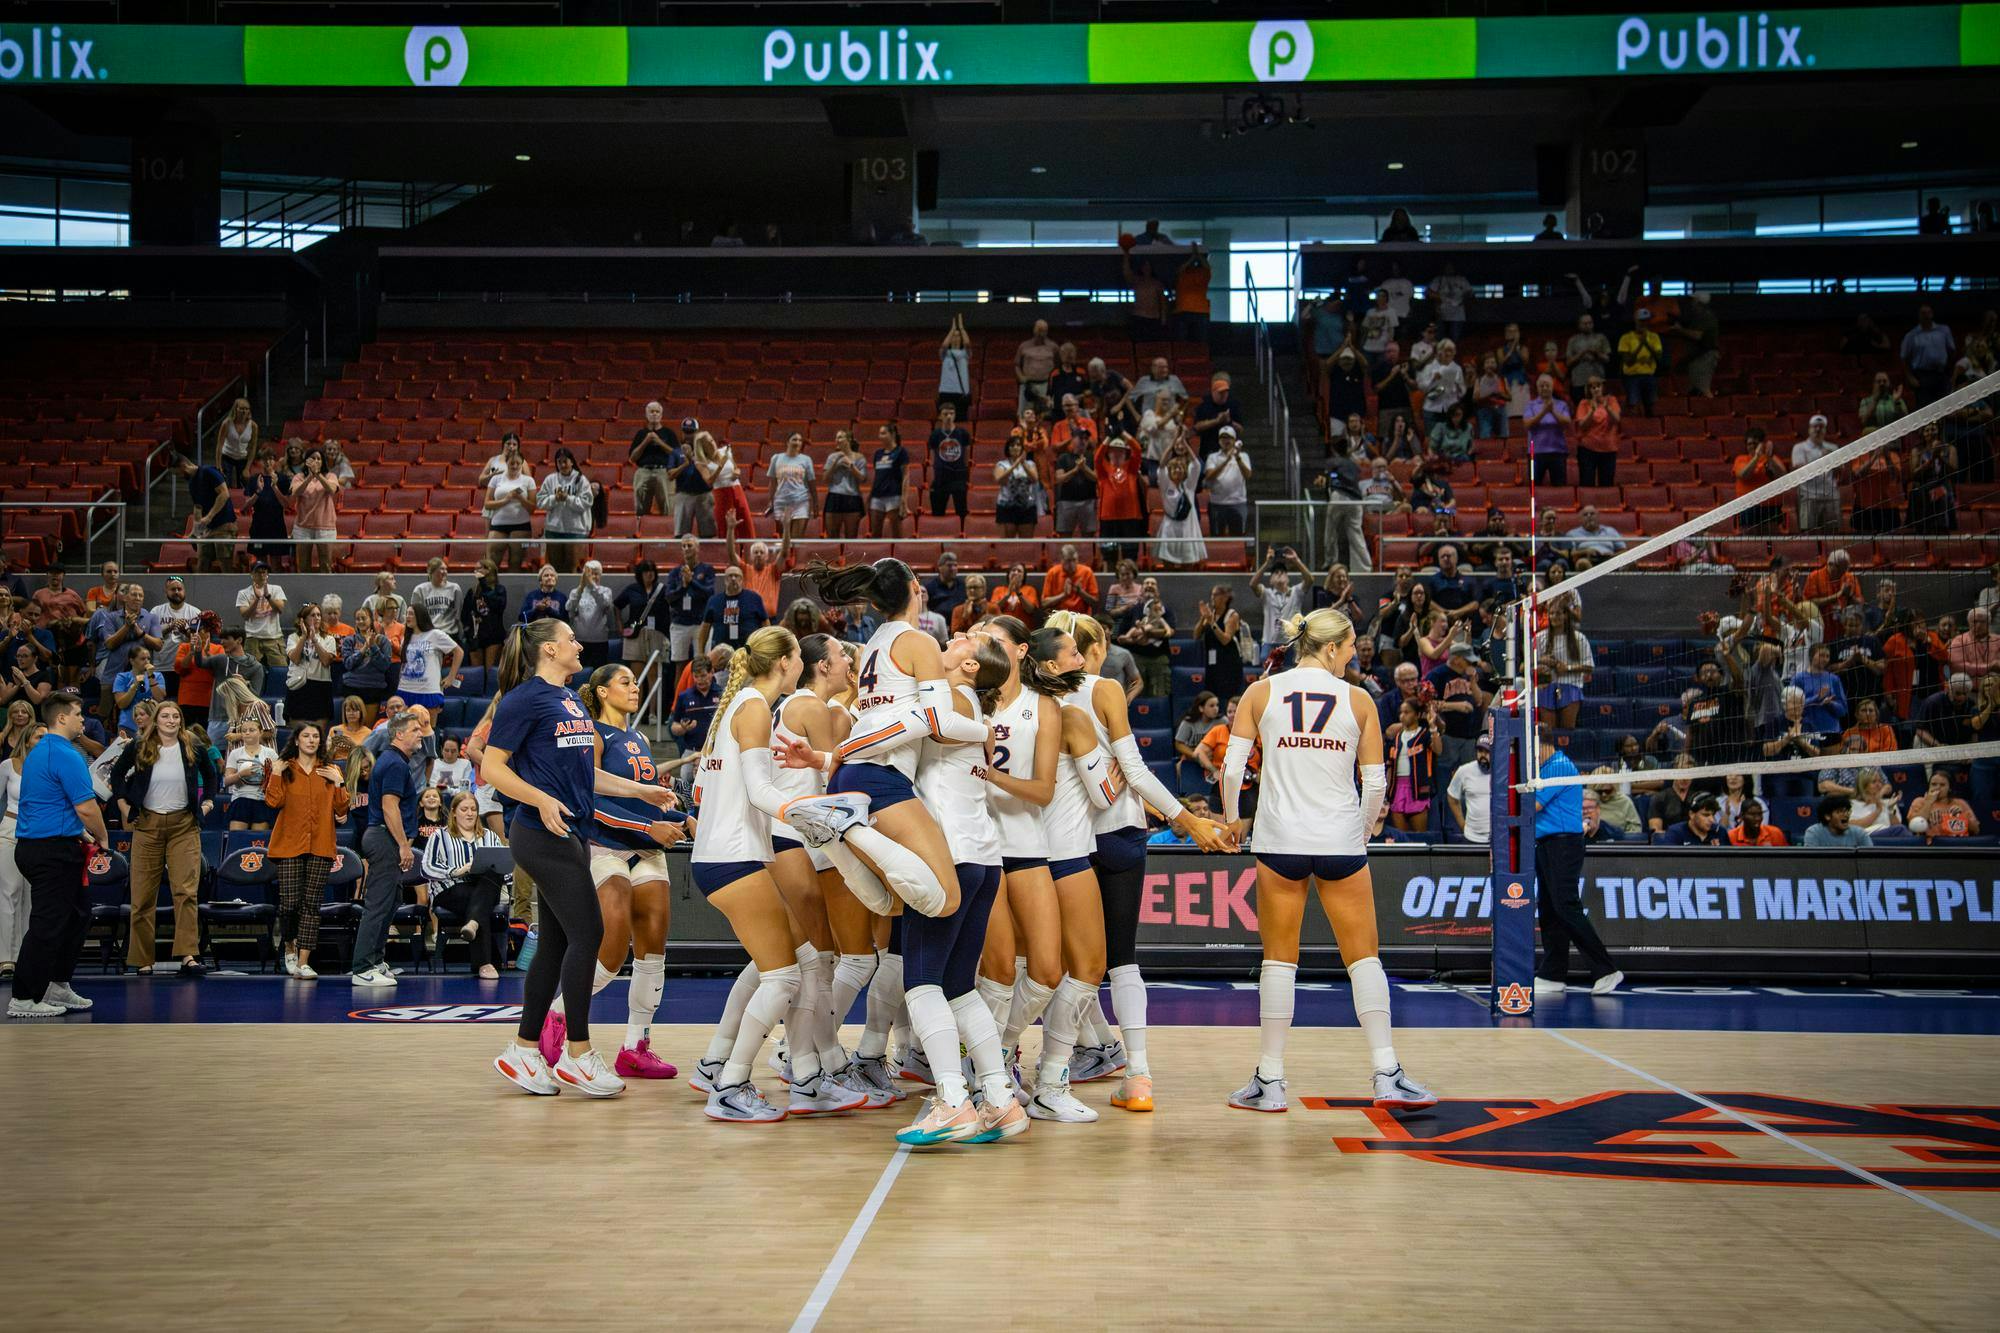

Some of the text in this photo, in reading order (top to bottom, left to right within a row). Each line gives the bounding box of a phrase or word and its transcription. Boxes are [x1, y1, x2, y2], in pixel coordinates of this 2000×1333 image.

[142, 158, 184, 181] 104
[861, 158, 906, 180] 103
[1591, 150, 1636, 174] 102
[859, 648, 879, 694] 4
[1283, 691, 1337, 734] 17
[1277, 736, 1347, 752] AUBURN
[628, 756, 656, 782] 15
[1139, 867, 1258, 931] EEK
[1595, 877, 1745, 919] TICKET
